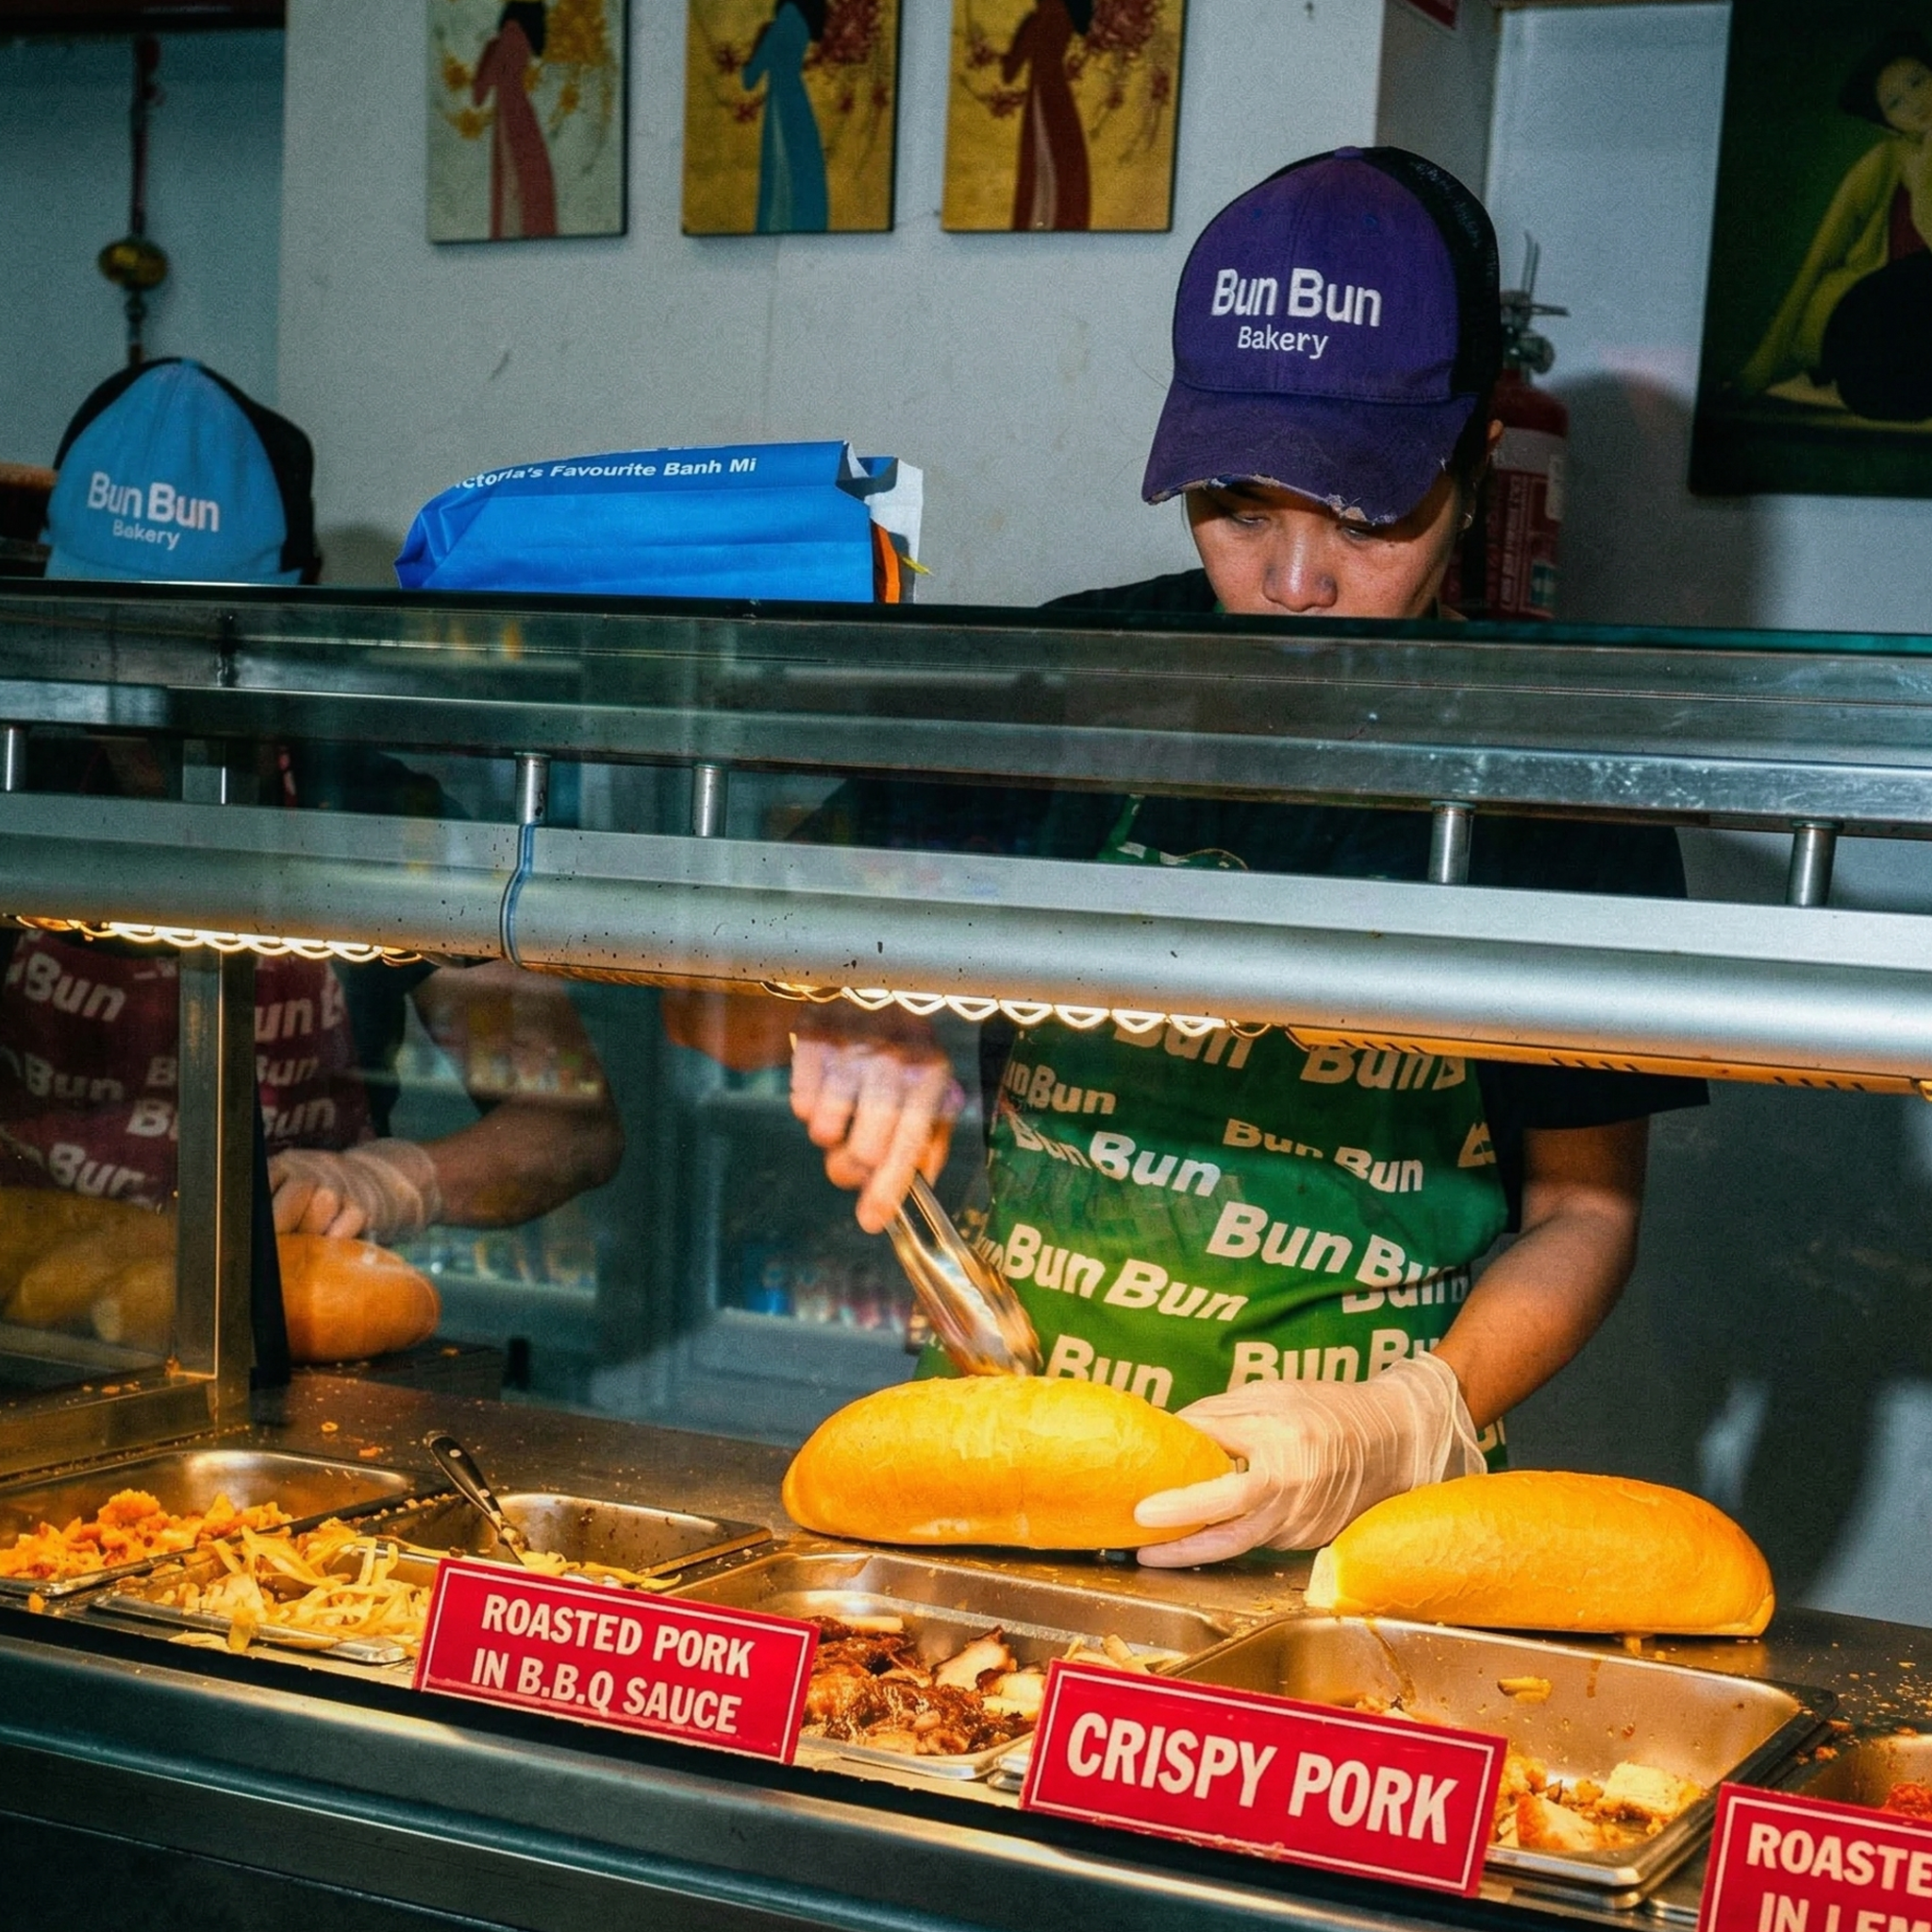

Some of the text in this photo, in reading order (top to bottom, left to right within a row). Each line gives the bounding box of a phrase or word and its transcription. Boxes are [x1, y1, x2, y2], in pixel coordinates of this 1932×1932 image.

[1210, 268, 1382, 326] Bun Bun
[1237, 324, 1329, 359] Bakery
[87, 471, 220, 532] Bun Bun
[455, 458, 758, 489] ctoria's Favourite Banh Mi
[112, 519, 180, 550] Bakery
[25, 951, 127, 1023] Bun
[1026, 1064, 1117, 1114] Bun
[1090, 1131, 1221, 1197] Bun
[1223, 1118, 1424, 1193] Bun Bun
[1206, 1201, 1353, 1274] Bun
[1001, 1224, 1106, 1299] Bun
[1103, 1258, 1249, 1321] Bun
[1045, 1334, 1173, 1408] Bun
[1227, 1341, 1359, 1393] Bun
[481, 1593, 756, 1678] ROASTED PORK
[471, 1647, 742, 1735] IN B.B.Q SAUCE
[1066, 1711, 1459, 1845] CRISPY PORK
[1746, 1822, 1932, 1899] ROASTE
[1757, 1891, 1809, 1932] IN
